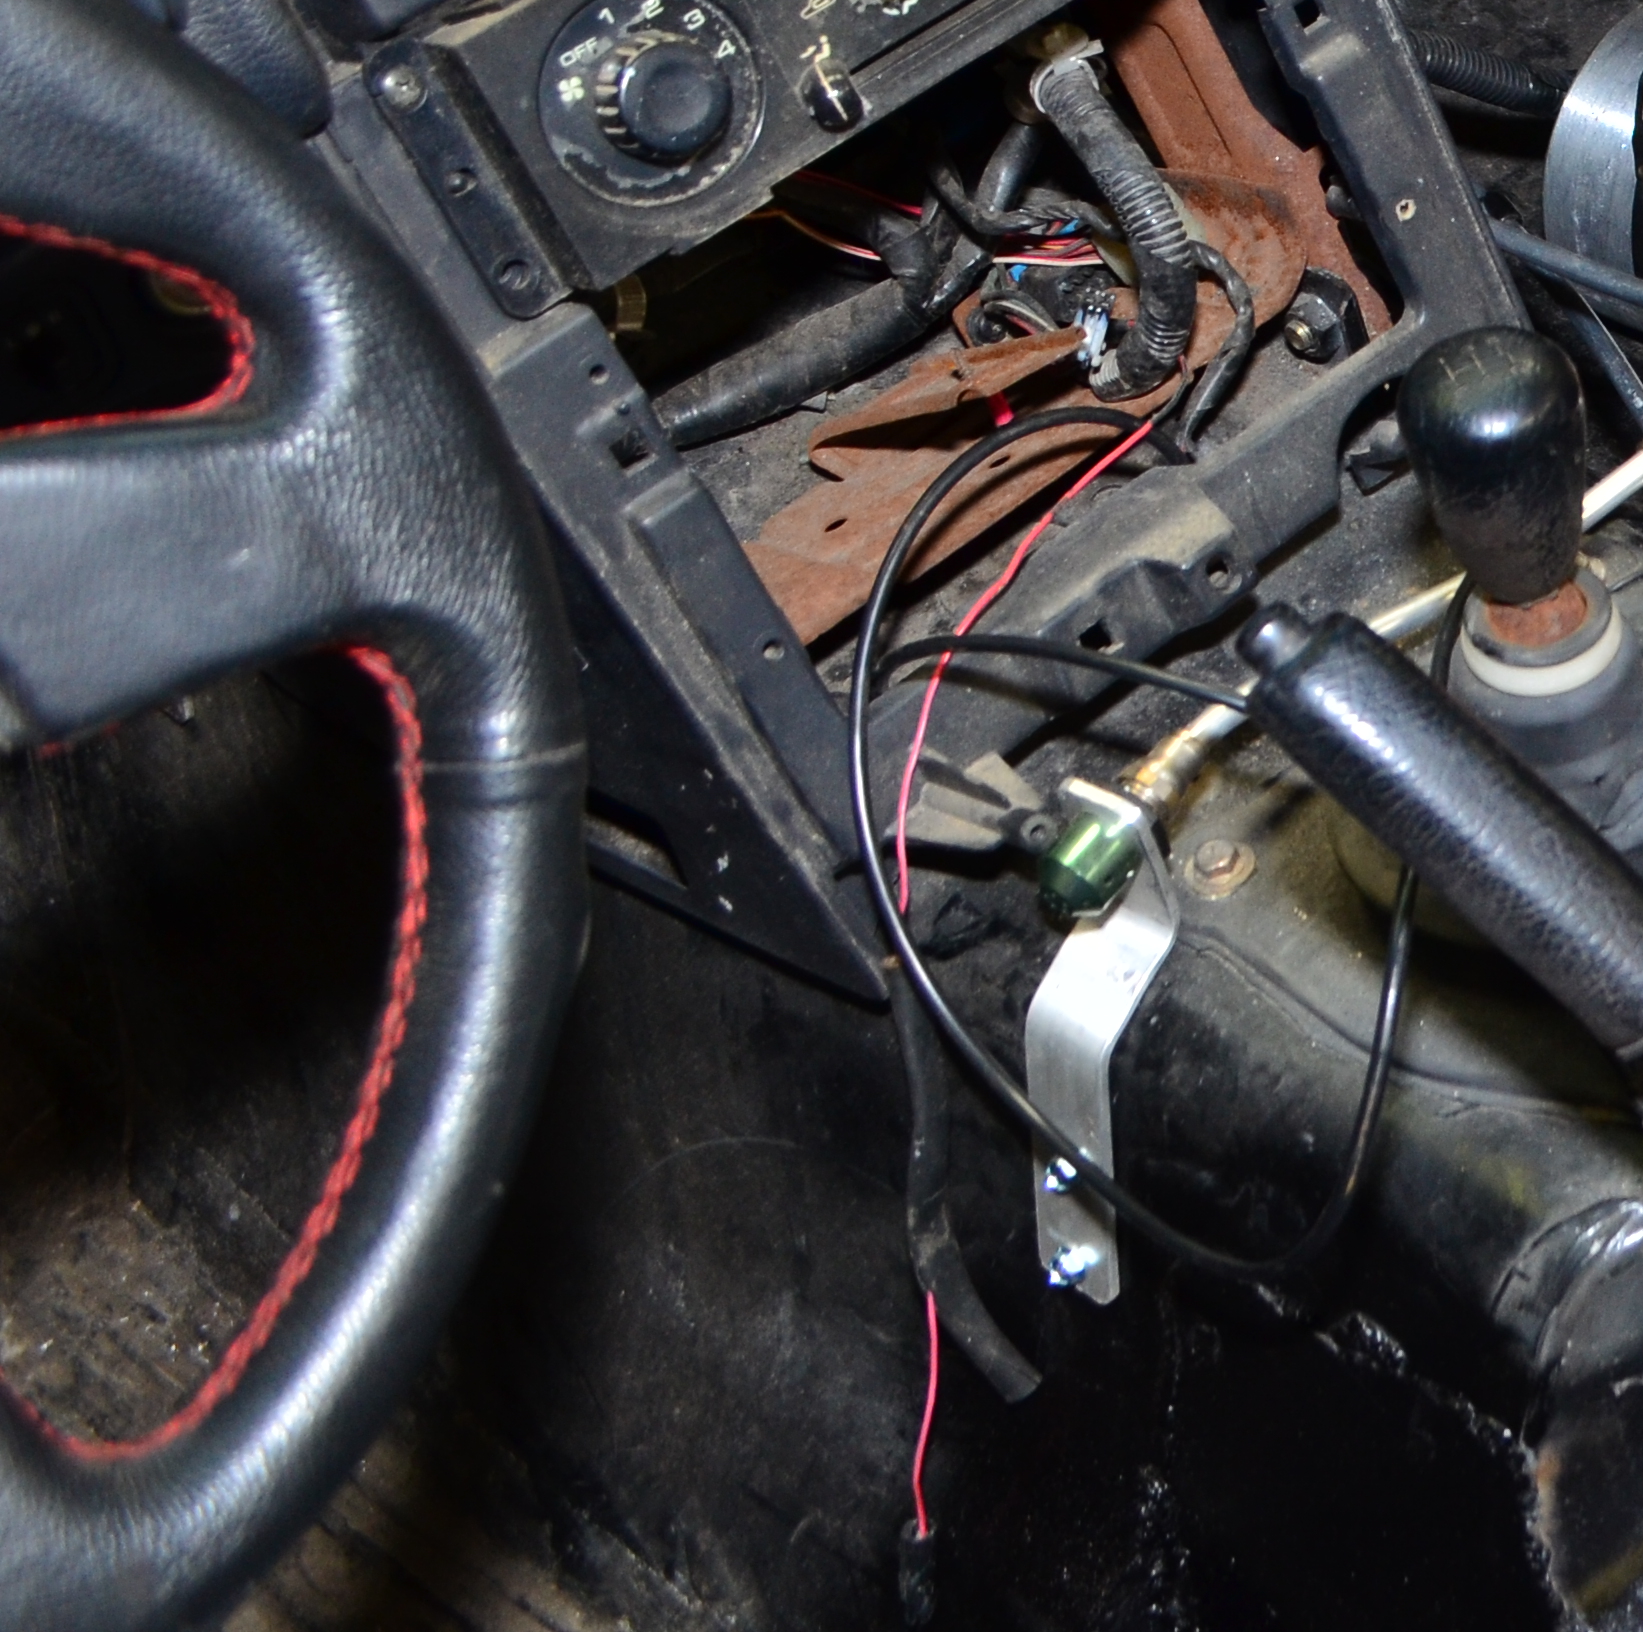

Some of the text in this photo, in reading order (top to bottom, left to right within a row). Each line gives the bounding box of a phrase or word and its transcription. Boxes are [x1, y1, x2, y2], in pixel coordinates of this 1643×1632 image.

[559, 36, 598, 67] OFF
[598, 7, 615, 25] 1
[683, 8, 706, 31] 3
[714, 39, 737, 59] 4
